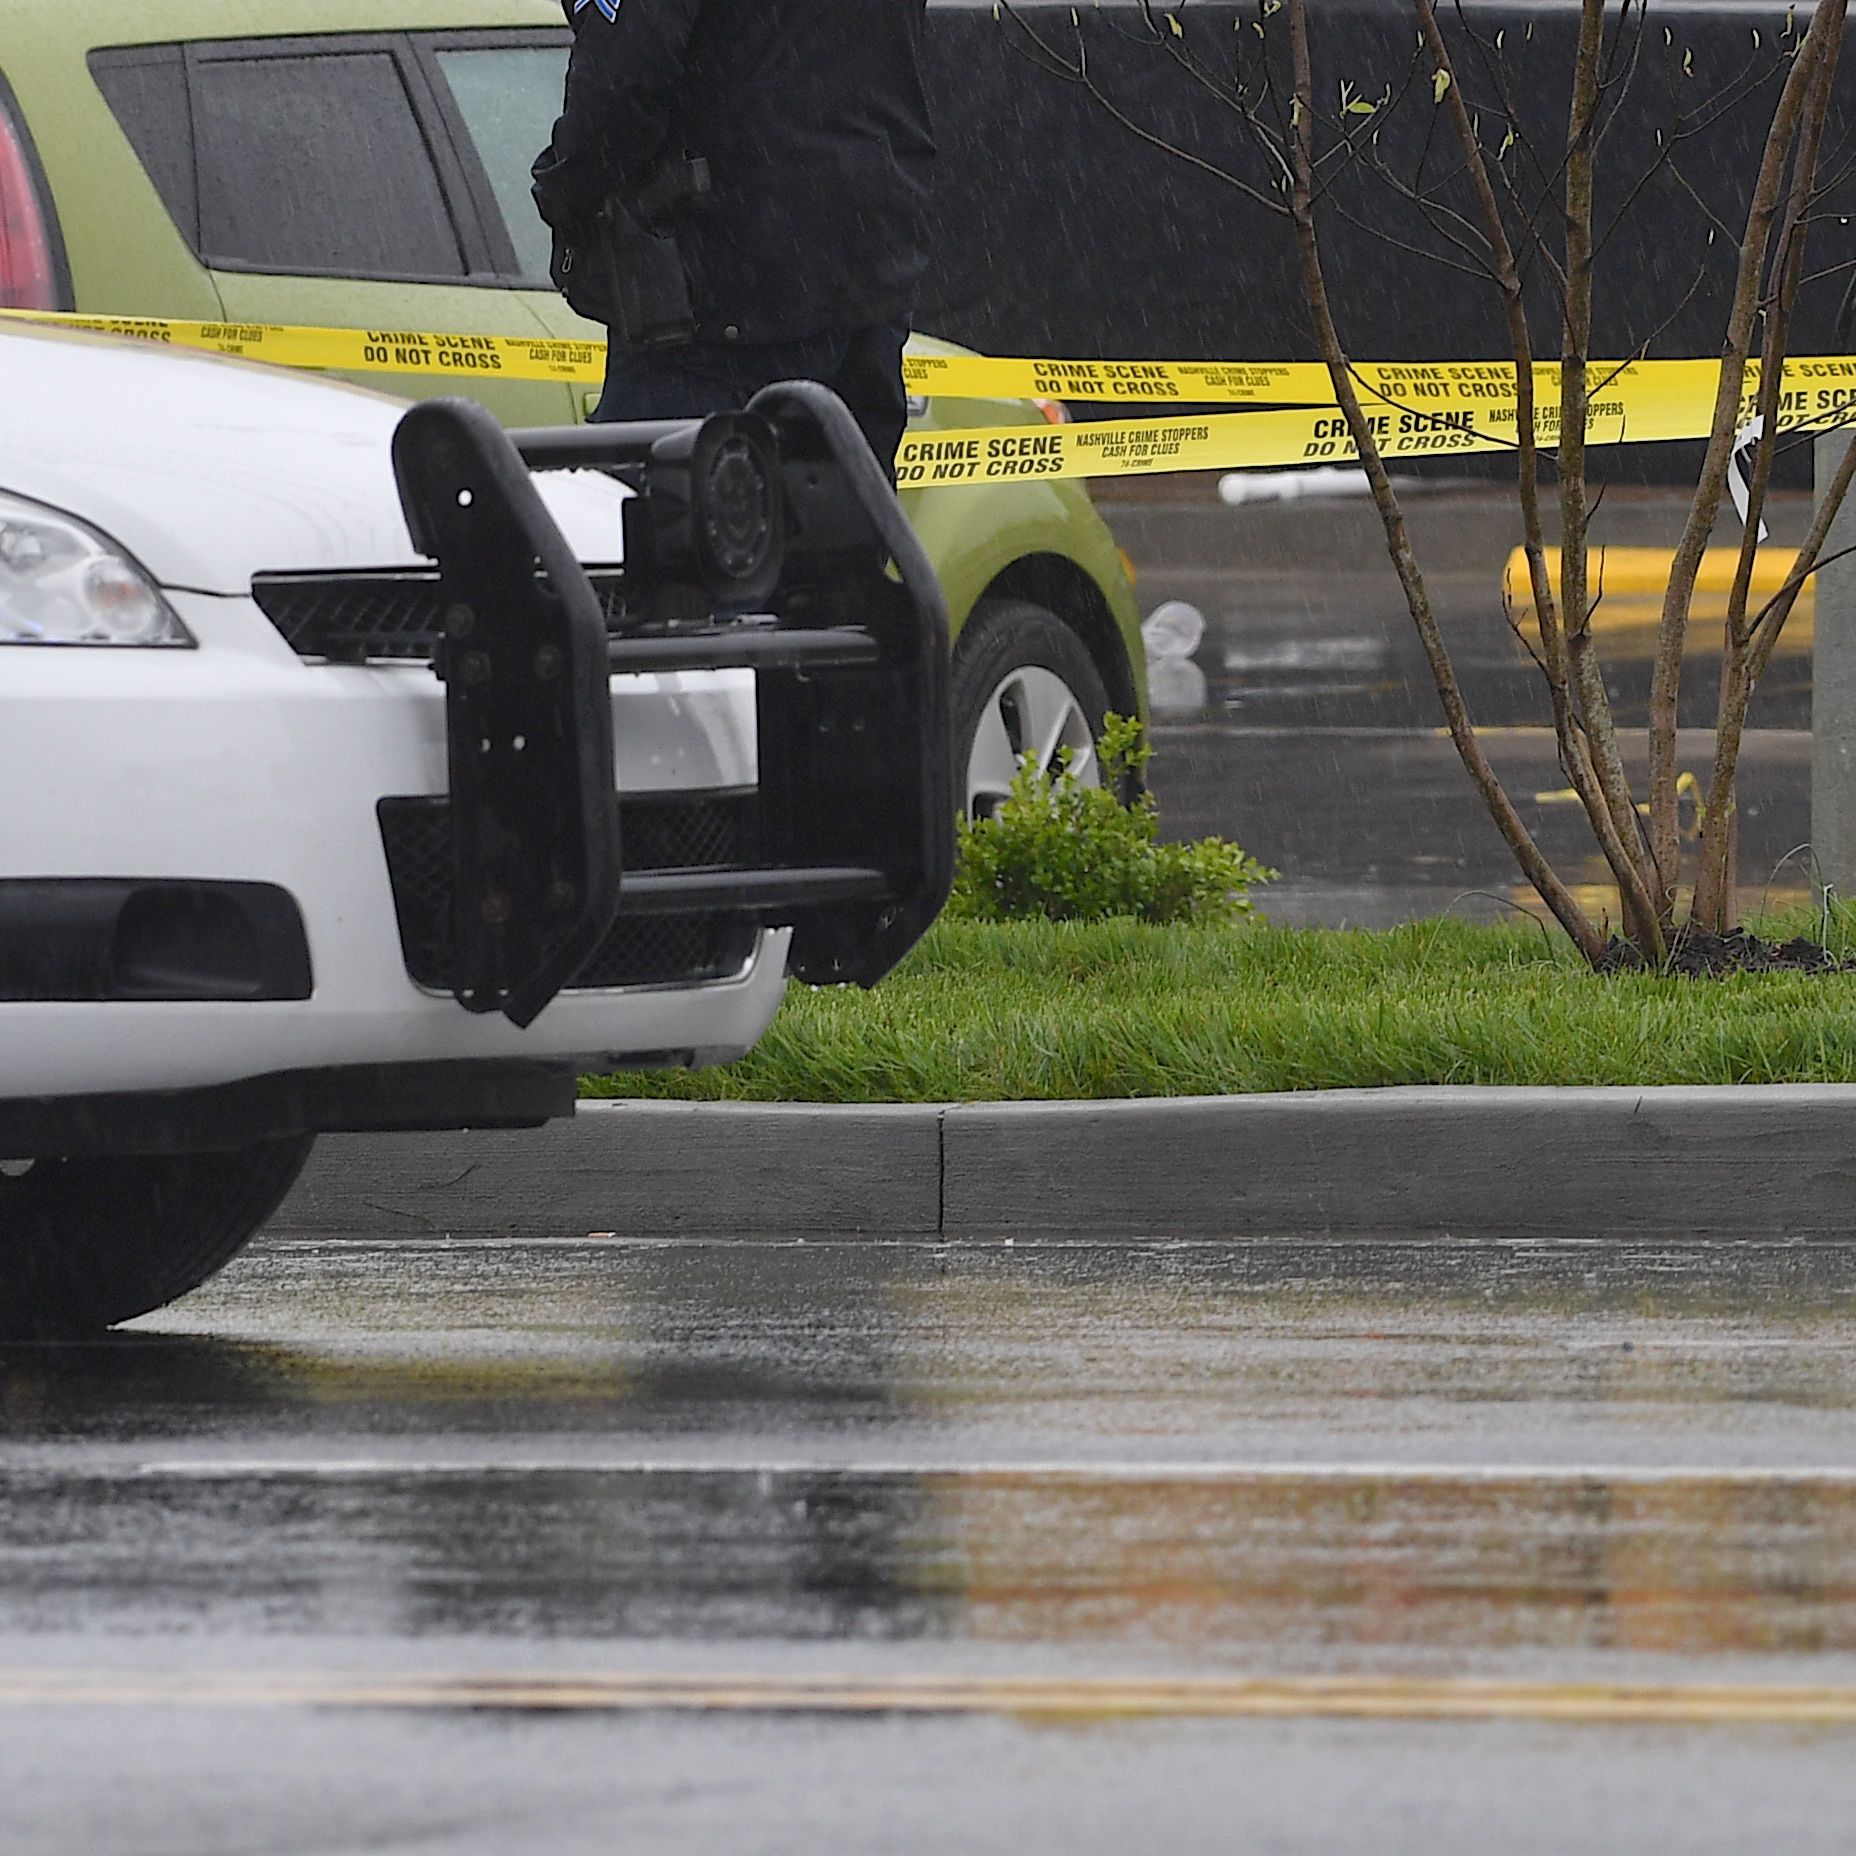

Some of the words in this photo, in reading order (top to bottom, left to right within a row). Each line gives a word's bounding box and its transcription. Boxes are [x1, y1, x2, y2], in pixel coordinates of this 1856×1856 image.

[367, 331, 428, 346] CRIME
[435, 334, 496, 350] SCENE
[364, 346, 388, 363] DO
[395, 348, 432, 366] NOT
[438, 351, 502, 369] CROSS
[529, 349, 549, 360] CASH
[552, 350, 566, 362] FOR
[569, 351, 592, 364] CLUES
[1034, 363, 1097, 378] CRIME
[1103, 365, 1169, 379] SCENE
[1377, 367, 1444, 380] CRIME
[1450, 367, 1514, 380] SCENE
[1035, 380, 1062, 393] DO
[1068, 381, 1105, 394] NOT
[1113, 381, 1180, 396] CROSS
[1379, 383, 1408, 397] DO
[1413, 383, 1451, 397] NOT
[1458, 383, 1518, 398] CROSS
[1489, 407, 1539, 422] NASHE
[1587, 401, 1624, 417] OPPERS
[1399, 410, 1474, 434] SCENE
[1076, 431, 1126, 447] NASHVILLE
[1128, 429, 1158, 444] CRIME
[1161, 427, 1209, 442] STOPPERS
[1303, 442, 1335, 457] DO
[1343, 438, 1391, 454] NT
[1396, 434, 1475, 451] CROSS
[903, 441, 980, 462] CRIME
[987, 436, 1063, 458] SCENE
[1102, 445, 1127, 458] CASH
[1129, 444, 1148, 456] FOR
[1150, 443, 1180, 455] CLUES
[897, 466, 925, 481] DO
[931, 462, 980, 479] NOT
[986, 458, 1064, 476] CROSS
